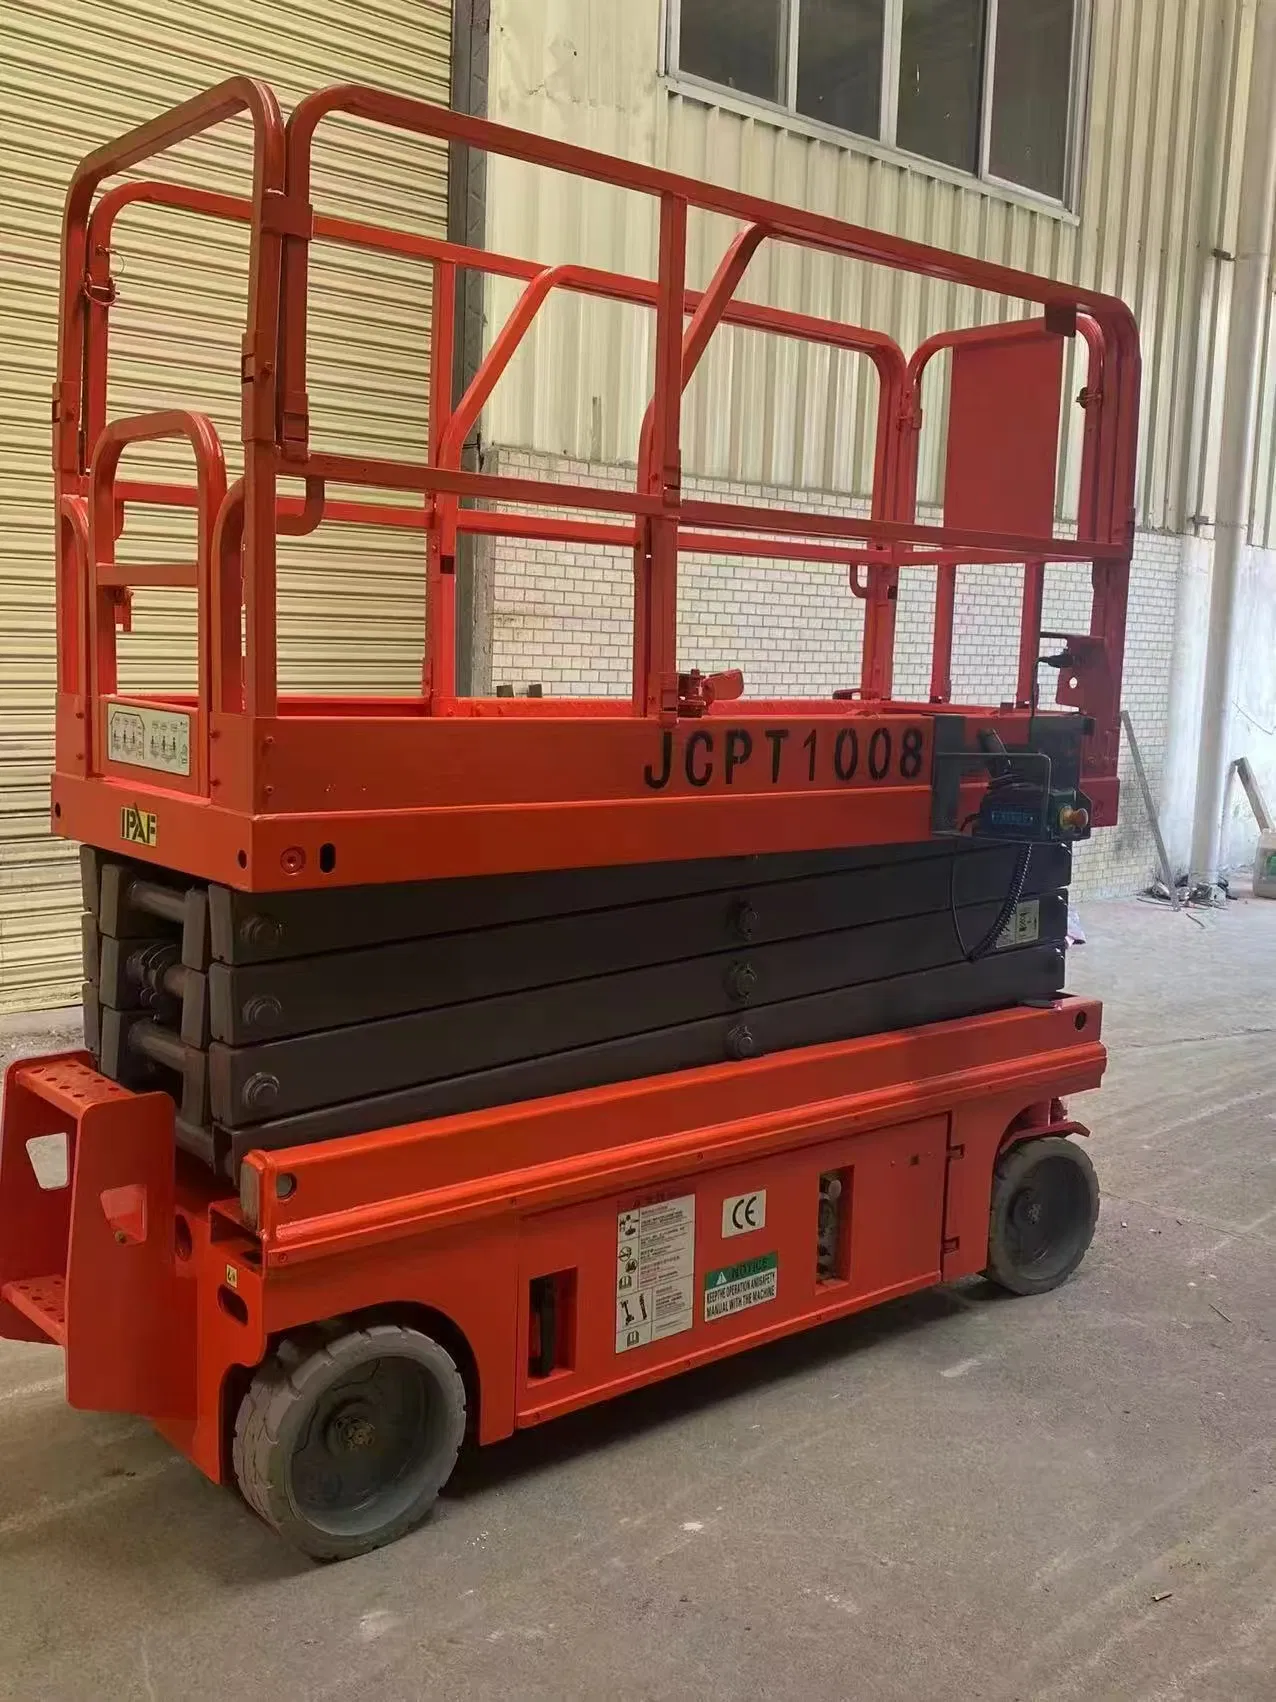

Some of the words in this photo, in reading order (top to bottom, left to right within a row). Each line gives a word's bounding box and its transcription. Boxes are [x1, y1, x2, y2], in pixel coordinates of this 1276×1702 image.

[643, 727, 924, 790] JCPT1008
[121, 802, 157, 844] IPAF
[731, 1258, 768, 1279] NOTICE
[706, 1299, 729, 1318] MANUAL
[729, 1296, 742, 1311] WITH
[742, 1292, 752, 1306] THE
[752, 1284, 775, 1303] MACHINE
[726, 1280, 751, 1298] OPERATION
